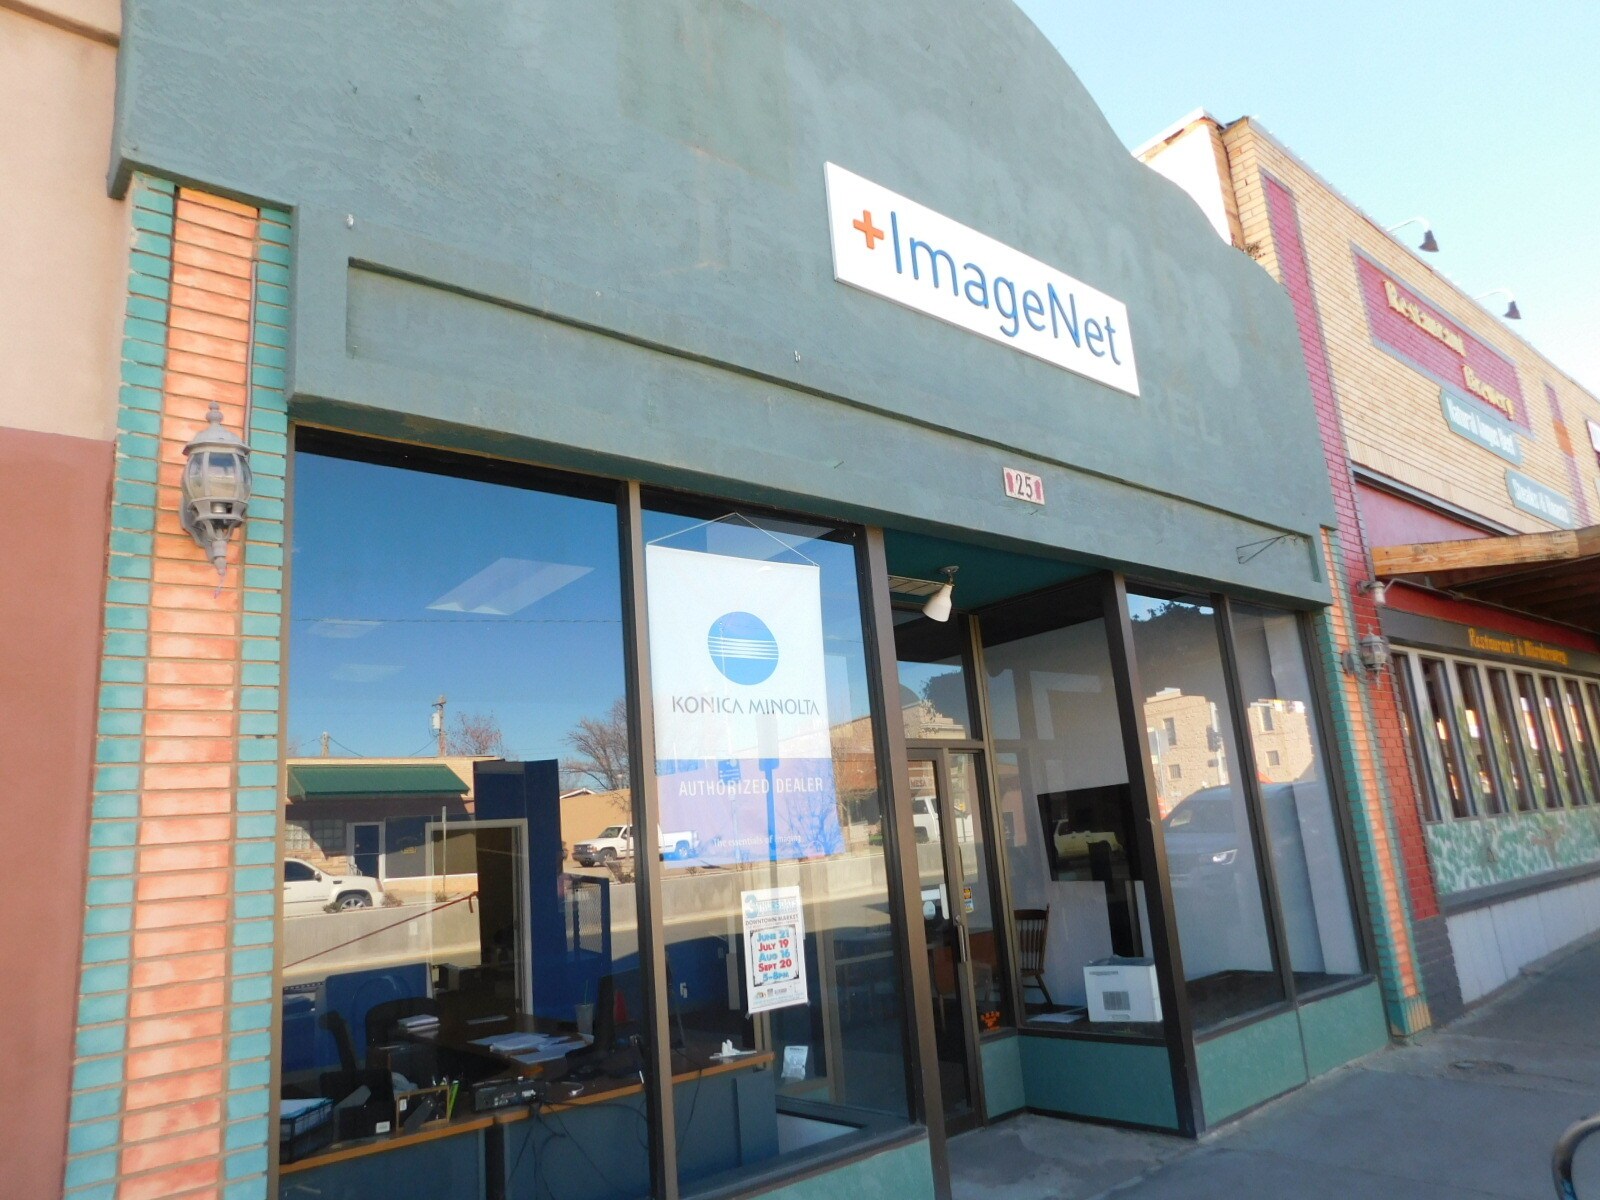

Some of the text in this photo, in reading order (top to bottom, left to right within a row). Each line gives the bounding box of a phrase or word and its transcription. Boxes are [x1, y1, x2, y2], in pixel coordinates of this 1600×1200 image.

[891, 211, 1121, 365] ImageNet
[1015, 473, 1033, 499] 25
[671, 696, 820, 716] KONICA MINOLTA
[679, 777, 824, 797] AUTHORIZED DEALER
[745, 894, 758, 919] 3
[745, 917, 778, 927] DOWNTOWN
[778, 914, 800, 922] MARKET
[779, 929, 790, 940] 21
[779, 939, 790, 949] 19
[780, 949, 791, 958] 16
[779, 959, 792, 970] 20
